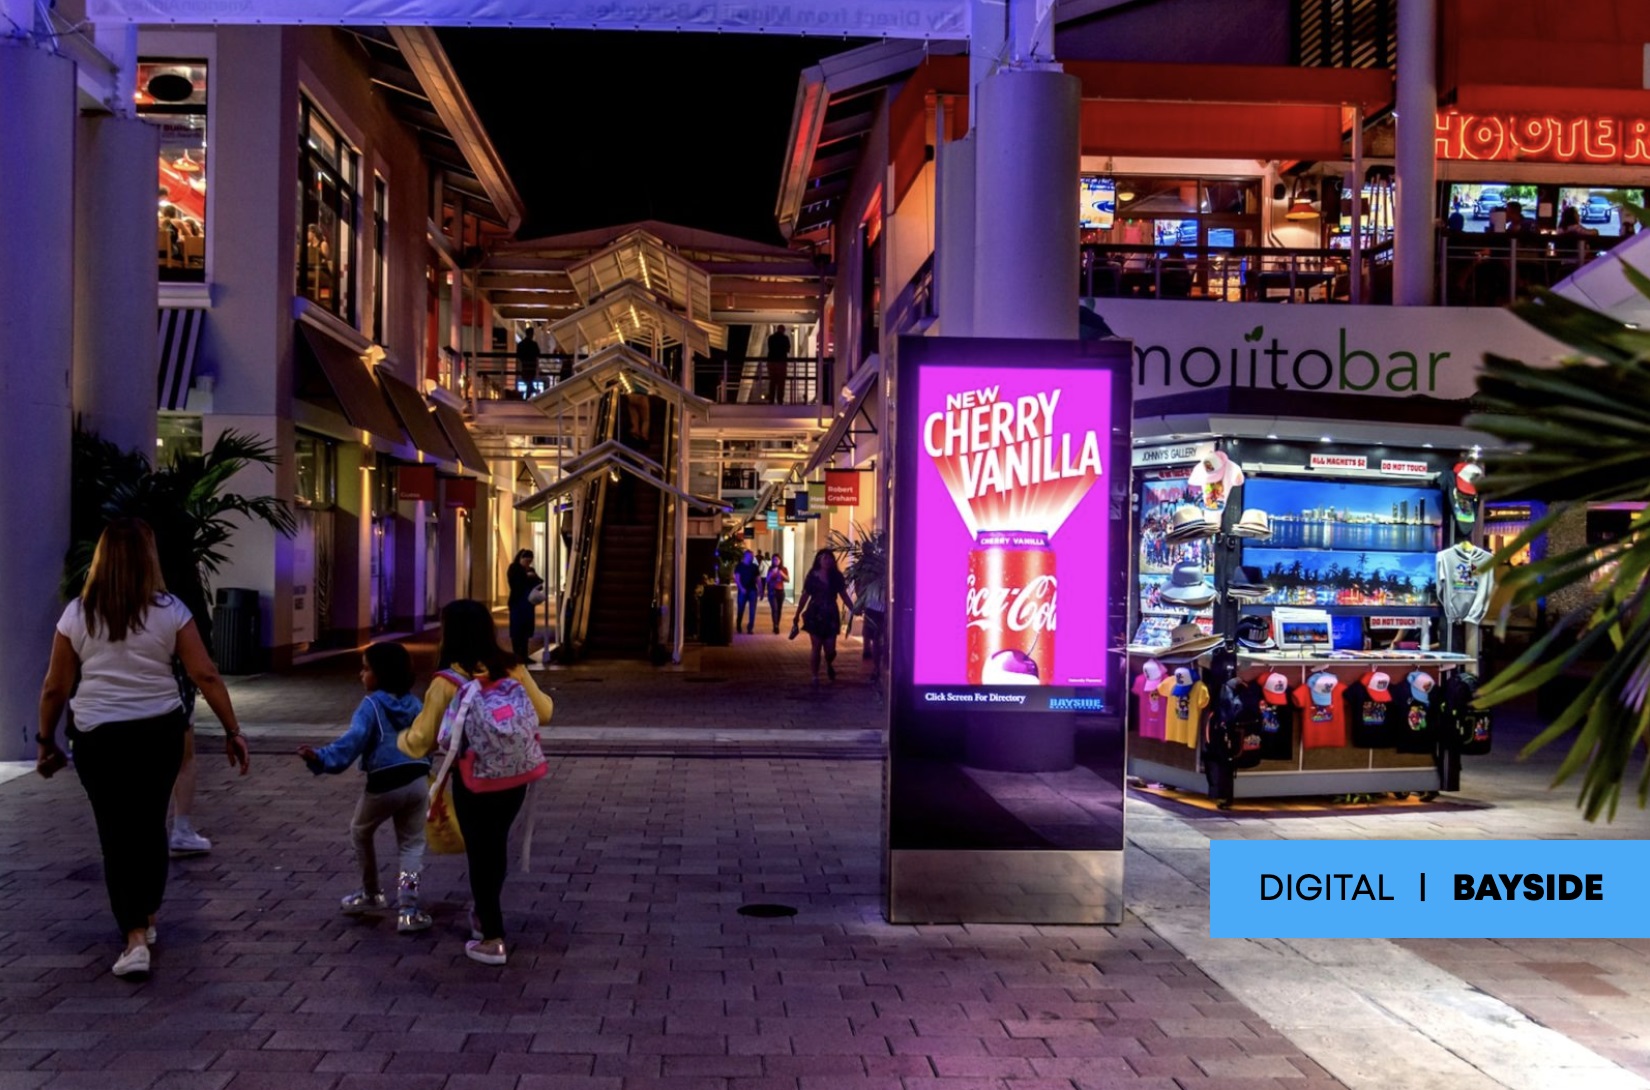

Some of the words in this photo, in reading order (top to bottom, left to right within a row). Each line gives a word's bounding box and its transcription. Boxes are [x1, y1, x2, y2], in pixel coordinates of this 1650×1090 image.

[946, 385, 1000, 411] NEW
[923, 388, 1062, 458] CHERRY
[1142, 450, 1168, 462] JOHNNY'S
[1171, 447, 1197, 459] GALLERY
[959, 430, 1103, 500] VANILLA
[1326, 458, 1356, 467] MAGNETS
[1382, 462, 1391, 470] DO
[1392, 463, 1406, 471] NOT
[1407, 464, 1428, 473] TOUCH
[828, 486, 853, 494] Robert
[980, 538, 1010, 546] CHERRY
[1013, 538, 1046, 546] VANILLA
[1371, 618, 1380, 626] DO
[1382, 618, 1394, 626] NOT
[1396, 618, 1416, 626] TOUCH
[925, 692, 946, 702] Click
[947, 693, 973, 702] Screen
[975, 693, 988, 702] For
[989, 693, 1026, 704] Directory
[1050, 698, 1101, 707] BAYSIDE
